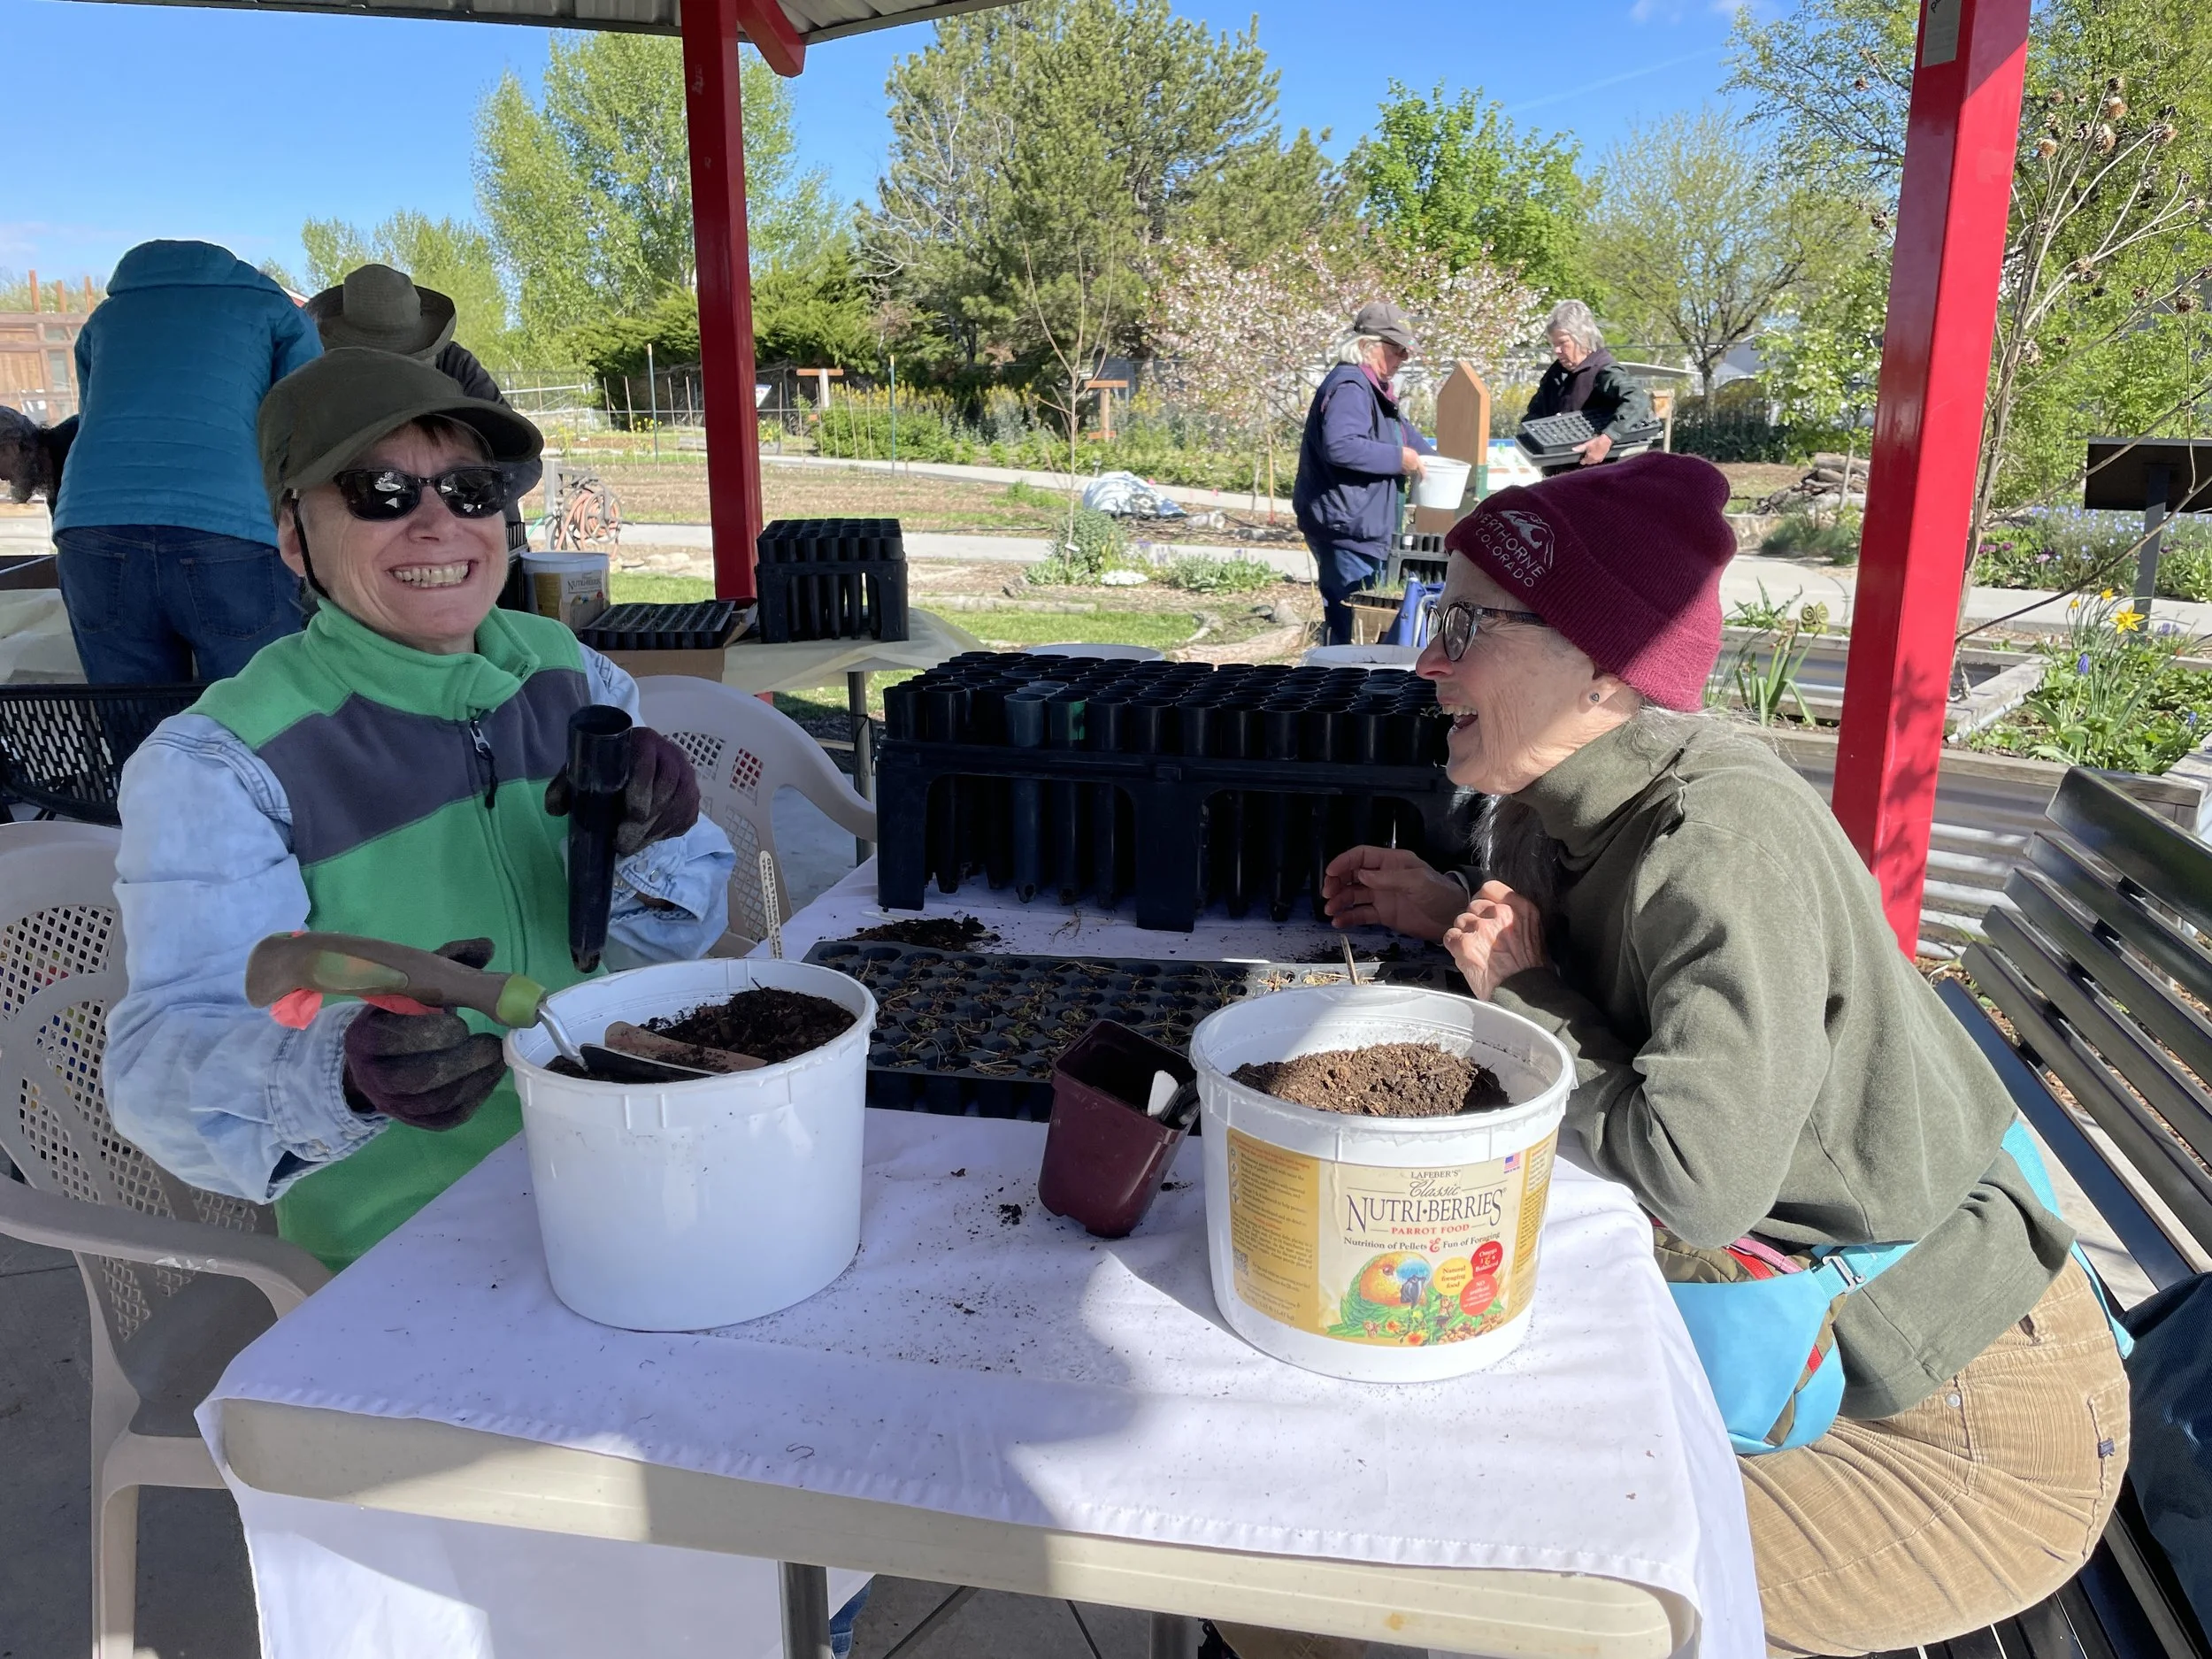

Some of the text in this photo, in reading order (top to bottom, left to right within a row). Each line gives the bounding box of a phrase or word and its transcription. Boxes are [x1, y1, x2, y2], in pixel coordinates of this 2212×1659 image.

[1475, 527, 1534, 588] COLORADO
[1411, 1169, 1460, 1179] LAFEBER'S
[1409, 1179, 1461, 1197] Classic
[1391, 1224, 1470, 1235] PARROT FOOD
[1344, 1237, 1385, 1248] Nutrition
[1399, 1241, 1427, 1250] Pellets
[1460, 1238, 1470, 1247] of
[1471, 1232, 1501, 1245] Foraging
